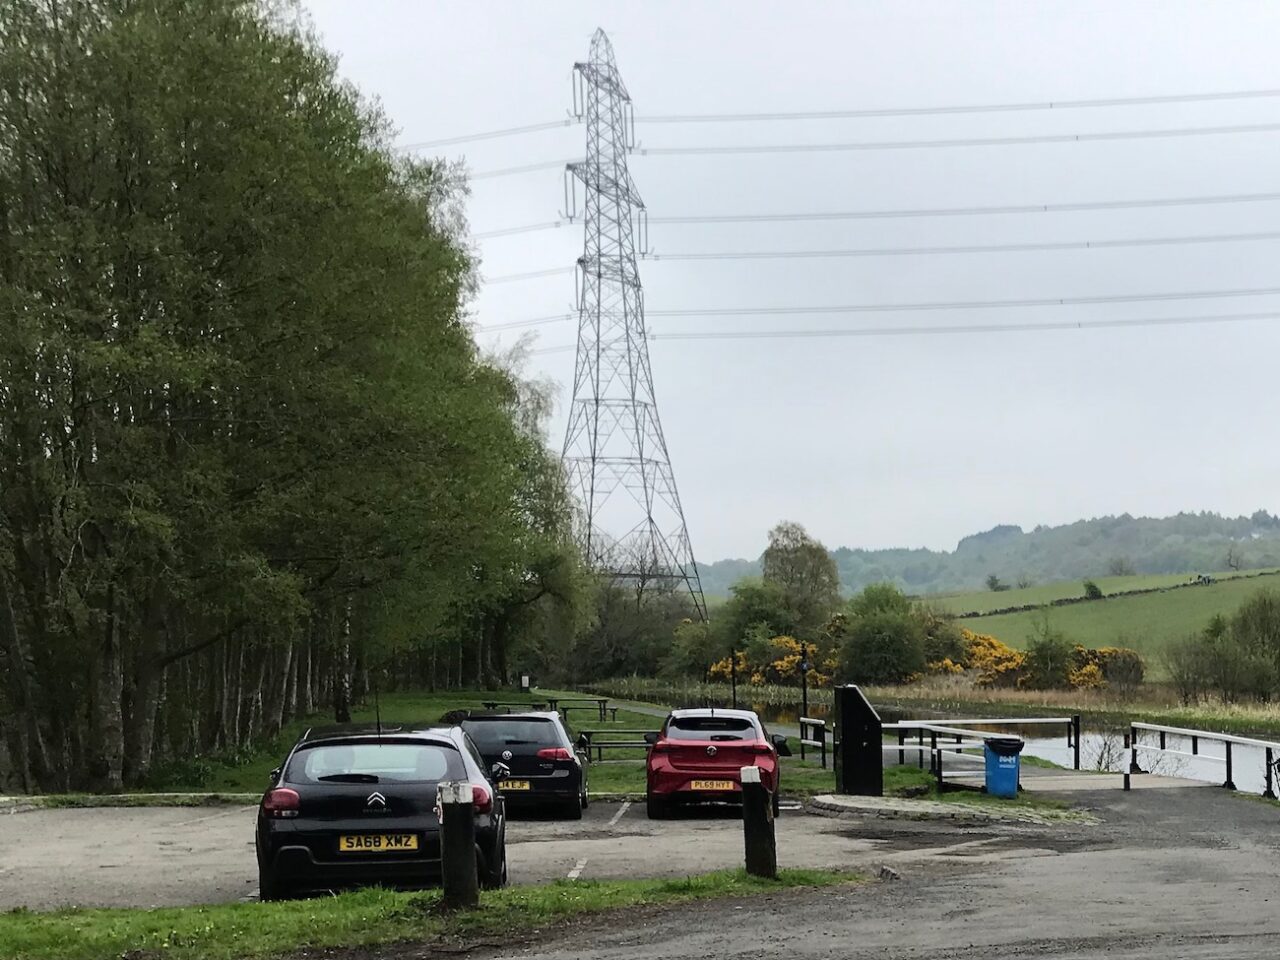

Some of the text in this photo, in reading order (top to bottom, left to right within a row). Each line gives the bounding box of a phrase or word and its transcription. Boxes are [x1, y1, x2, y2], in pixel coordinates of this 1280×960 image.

[694, 781, 731, 789] PL69 HYT
[346, 835, 412, 848] SA68 XMZ
